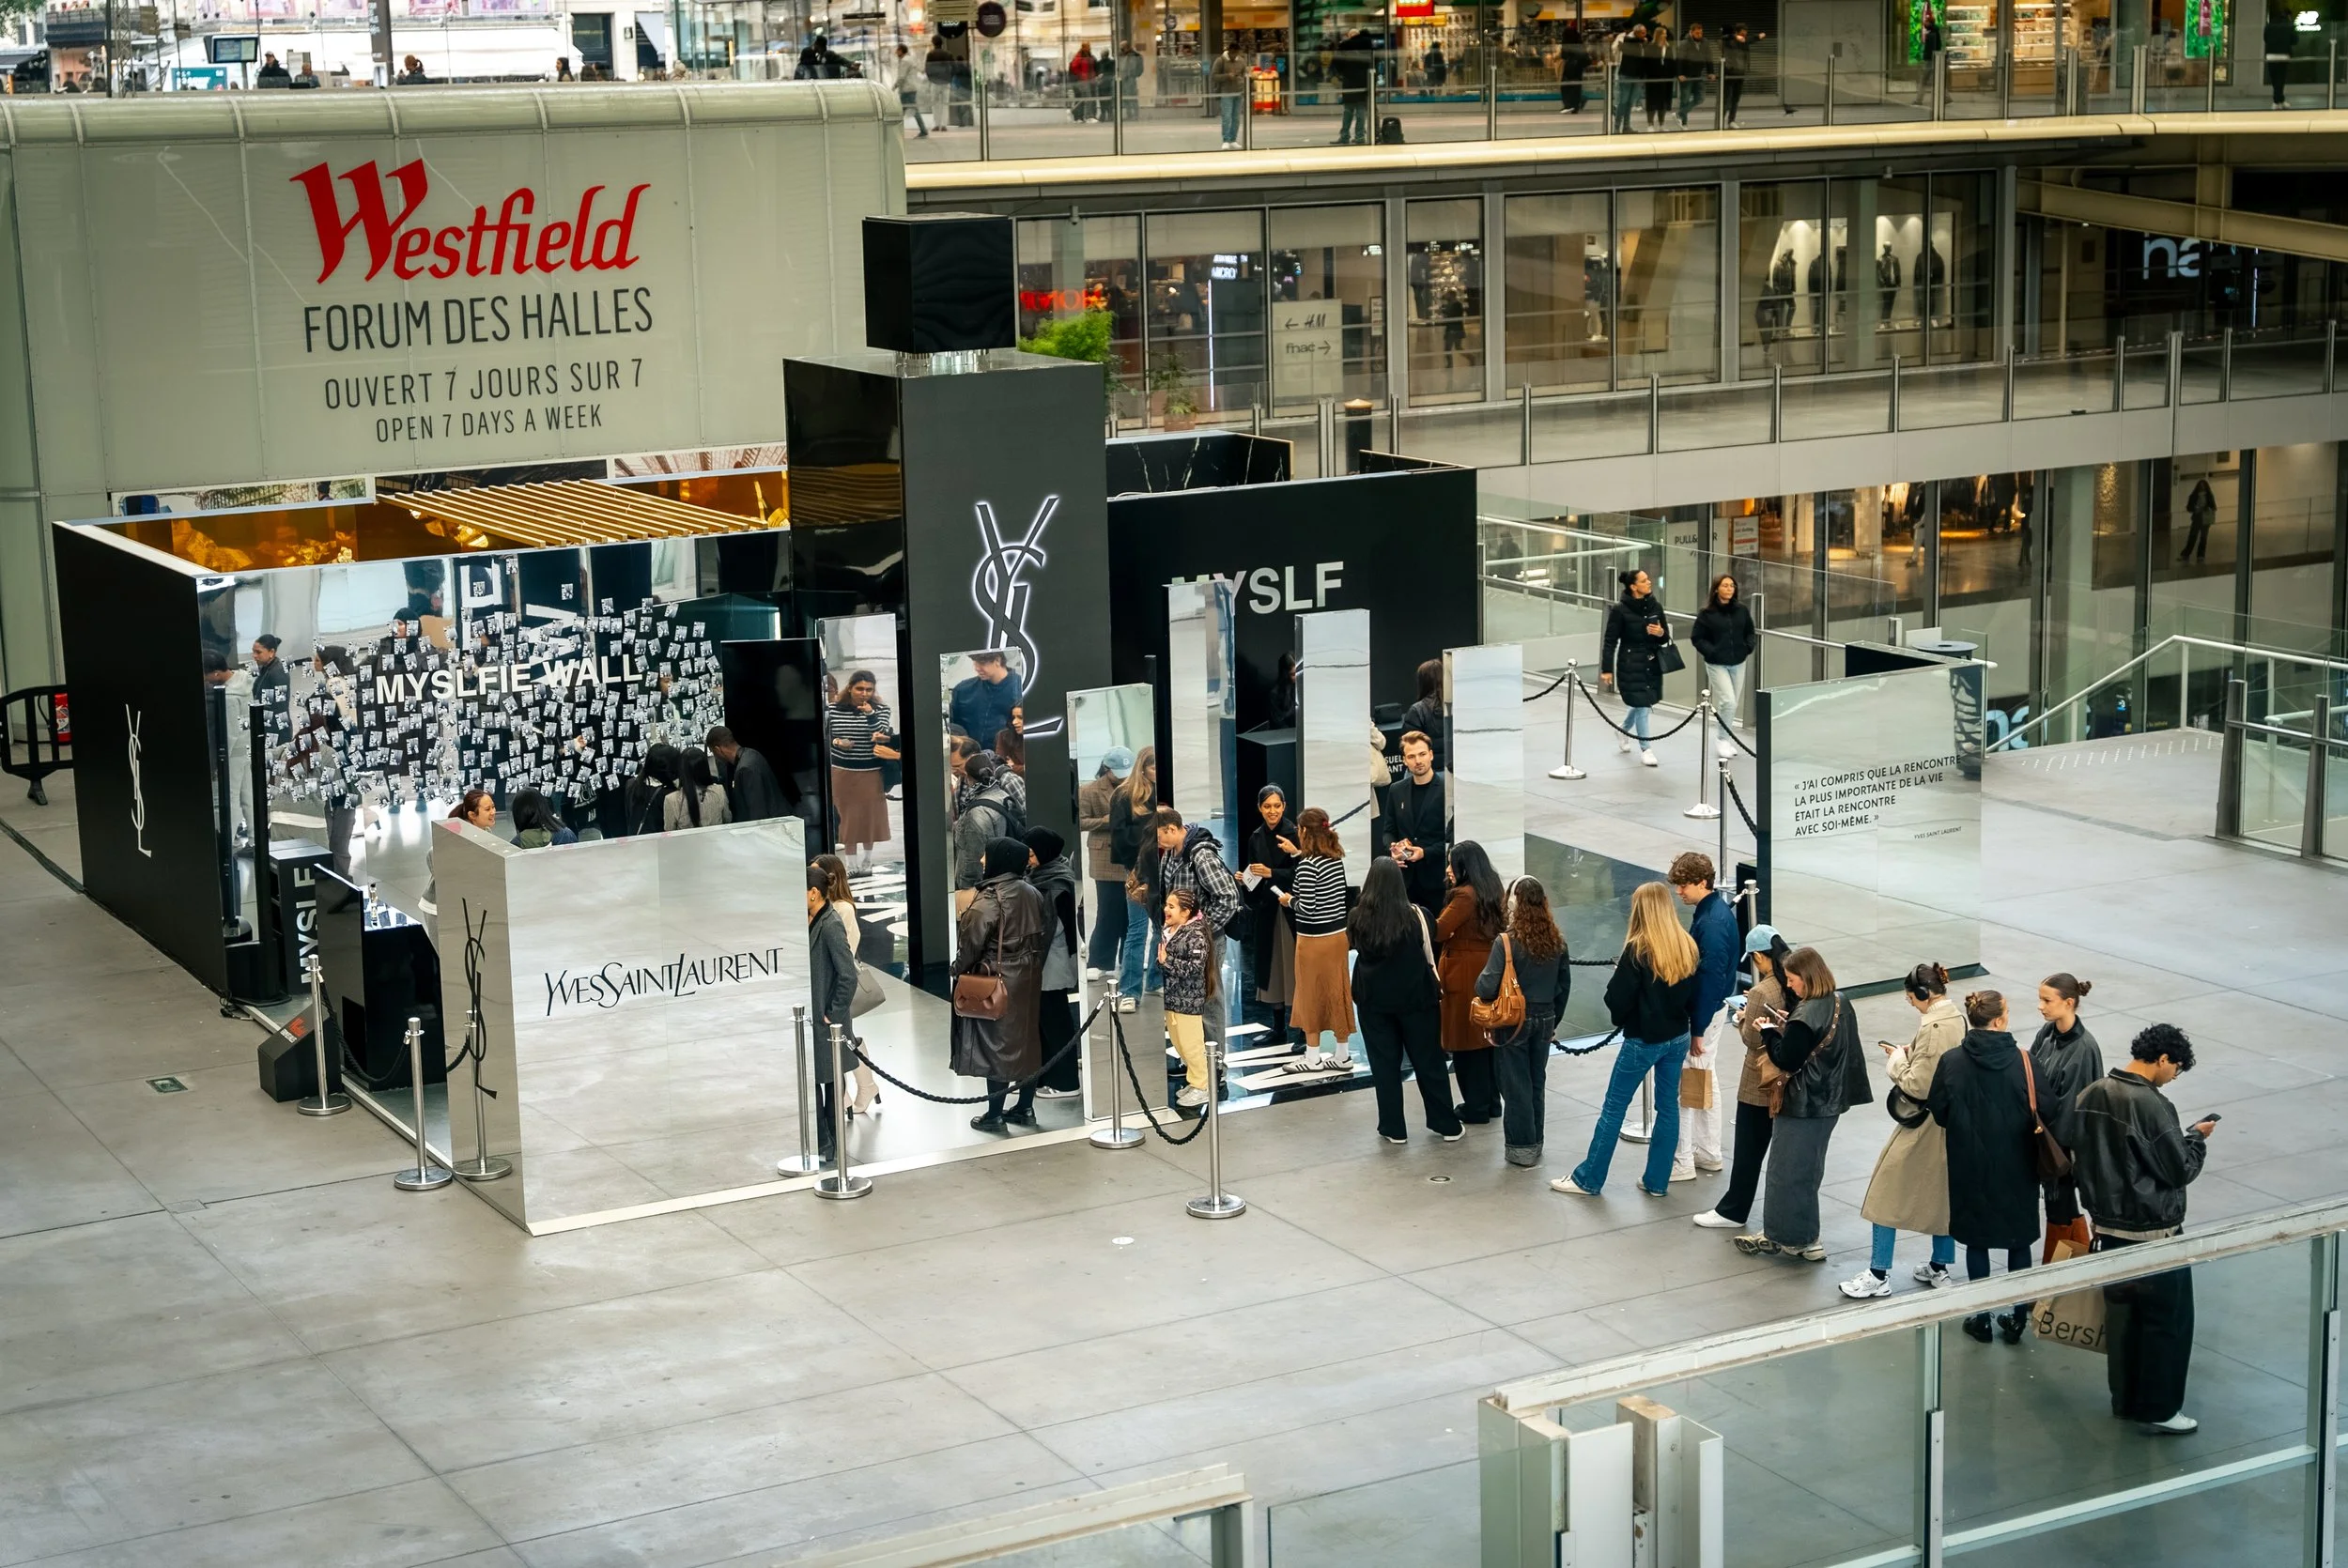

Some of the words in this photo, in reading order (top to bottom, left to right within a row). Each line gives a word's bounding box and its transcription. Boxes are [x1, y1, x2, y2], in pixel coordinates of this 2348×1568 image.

[289, 158, 651, 284] Westfield
[304, 300, 433, 352] FORUM
[444, 295, 510, 345] DES
[522, 286, 653, 339] HALLES
[1286, 343, 1315, 353] fnac
[325, 373, 432, 408] OUVERT
[445, 372, 456, 402] 7
[471, 364, 558, 400] JOURS
[571, 361, 620, 392] SUR
[631, 359, 642, 387] 7
[377, 416, 434, 443] OPEN
[442, 414, 452, 438] 7
[463, 410, 514, 437] DAYS
[525, 408, 536, 432] A
[546, 404, 602, 429] WEEK
[1171, 561, 1344, 615] YSLF
[376, 663, 533, 705] MYSLFIE
[543, 653, 643, 688] WALL
[1795, 795, 1807, 807] LA
[1809, 792, 1832, 805] PLUS
[1835, 780, 1896, 800] IMPORTANTE
[1899, 777, 1912, 789] DE
[1914, 775, 1926, 787] LA
[1928, 772, 1944, 784] VIE
[1802, 778, 1818, 791] J'AI
[1820, 770, 1864, 788] COMPRIS
[1867, 766, 1887, 781] QUE
[1890, 764, 1902, 776] LA
[1904, 754, 1962, 774] RENCONTRE
[1795, 807, 1820, 822] ÉTAIT
[1823, 805, 1836, 817] LA
[1838, 795, 1896, 815] RENCONTRE
[1795, 822, 1819, 837] AVEC
[1914, 831, 1926, 839] YVES
[1926, 829, 1940, 838] SAINT
[1941, 826, 1962, 836] LAURENT
